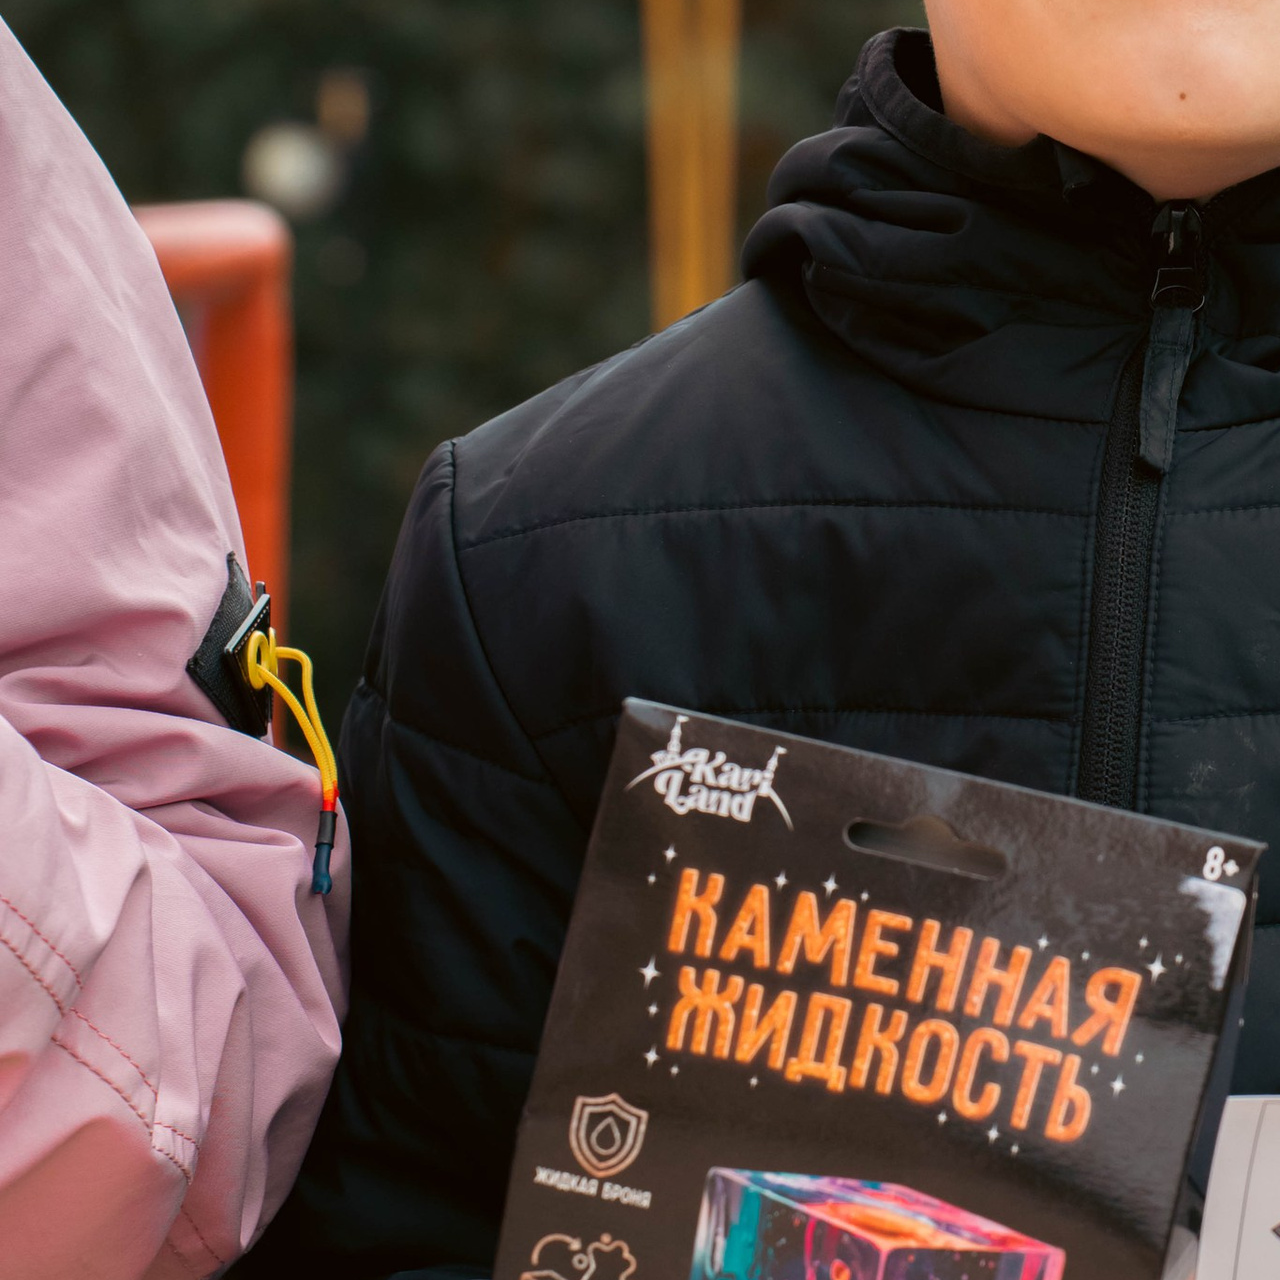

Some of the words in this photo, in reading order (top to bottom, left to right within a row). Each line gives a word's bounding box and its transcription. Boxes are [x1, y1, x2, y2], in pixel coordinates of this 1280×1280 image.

[654, 769, 757, 822] Land
[1203, 846, 1240, 881] 8+
[667, 867, 1142, 1057] КАМЕННАЯ
[666, 965, 1092, 1143] ЖИДКОСТЬ
[533, 1165, 599, 1197] ЖИДКАЯ
[601, 1182, 653, 1210] БРОНЯ
